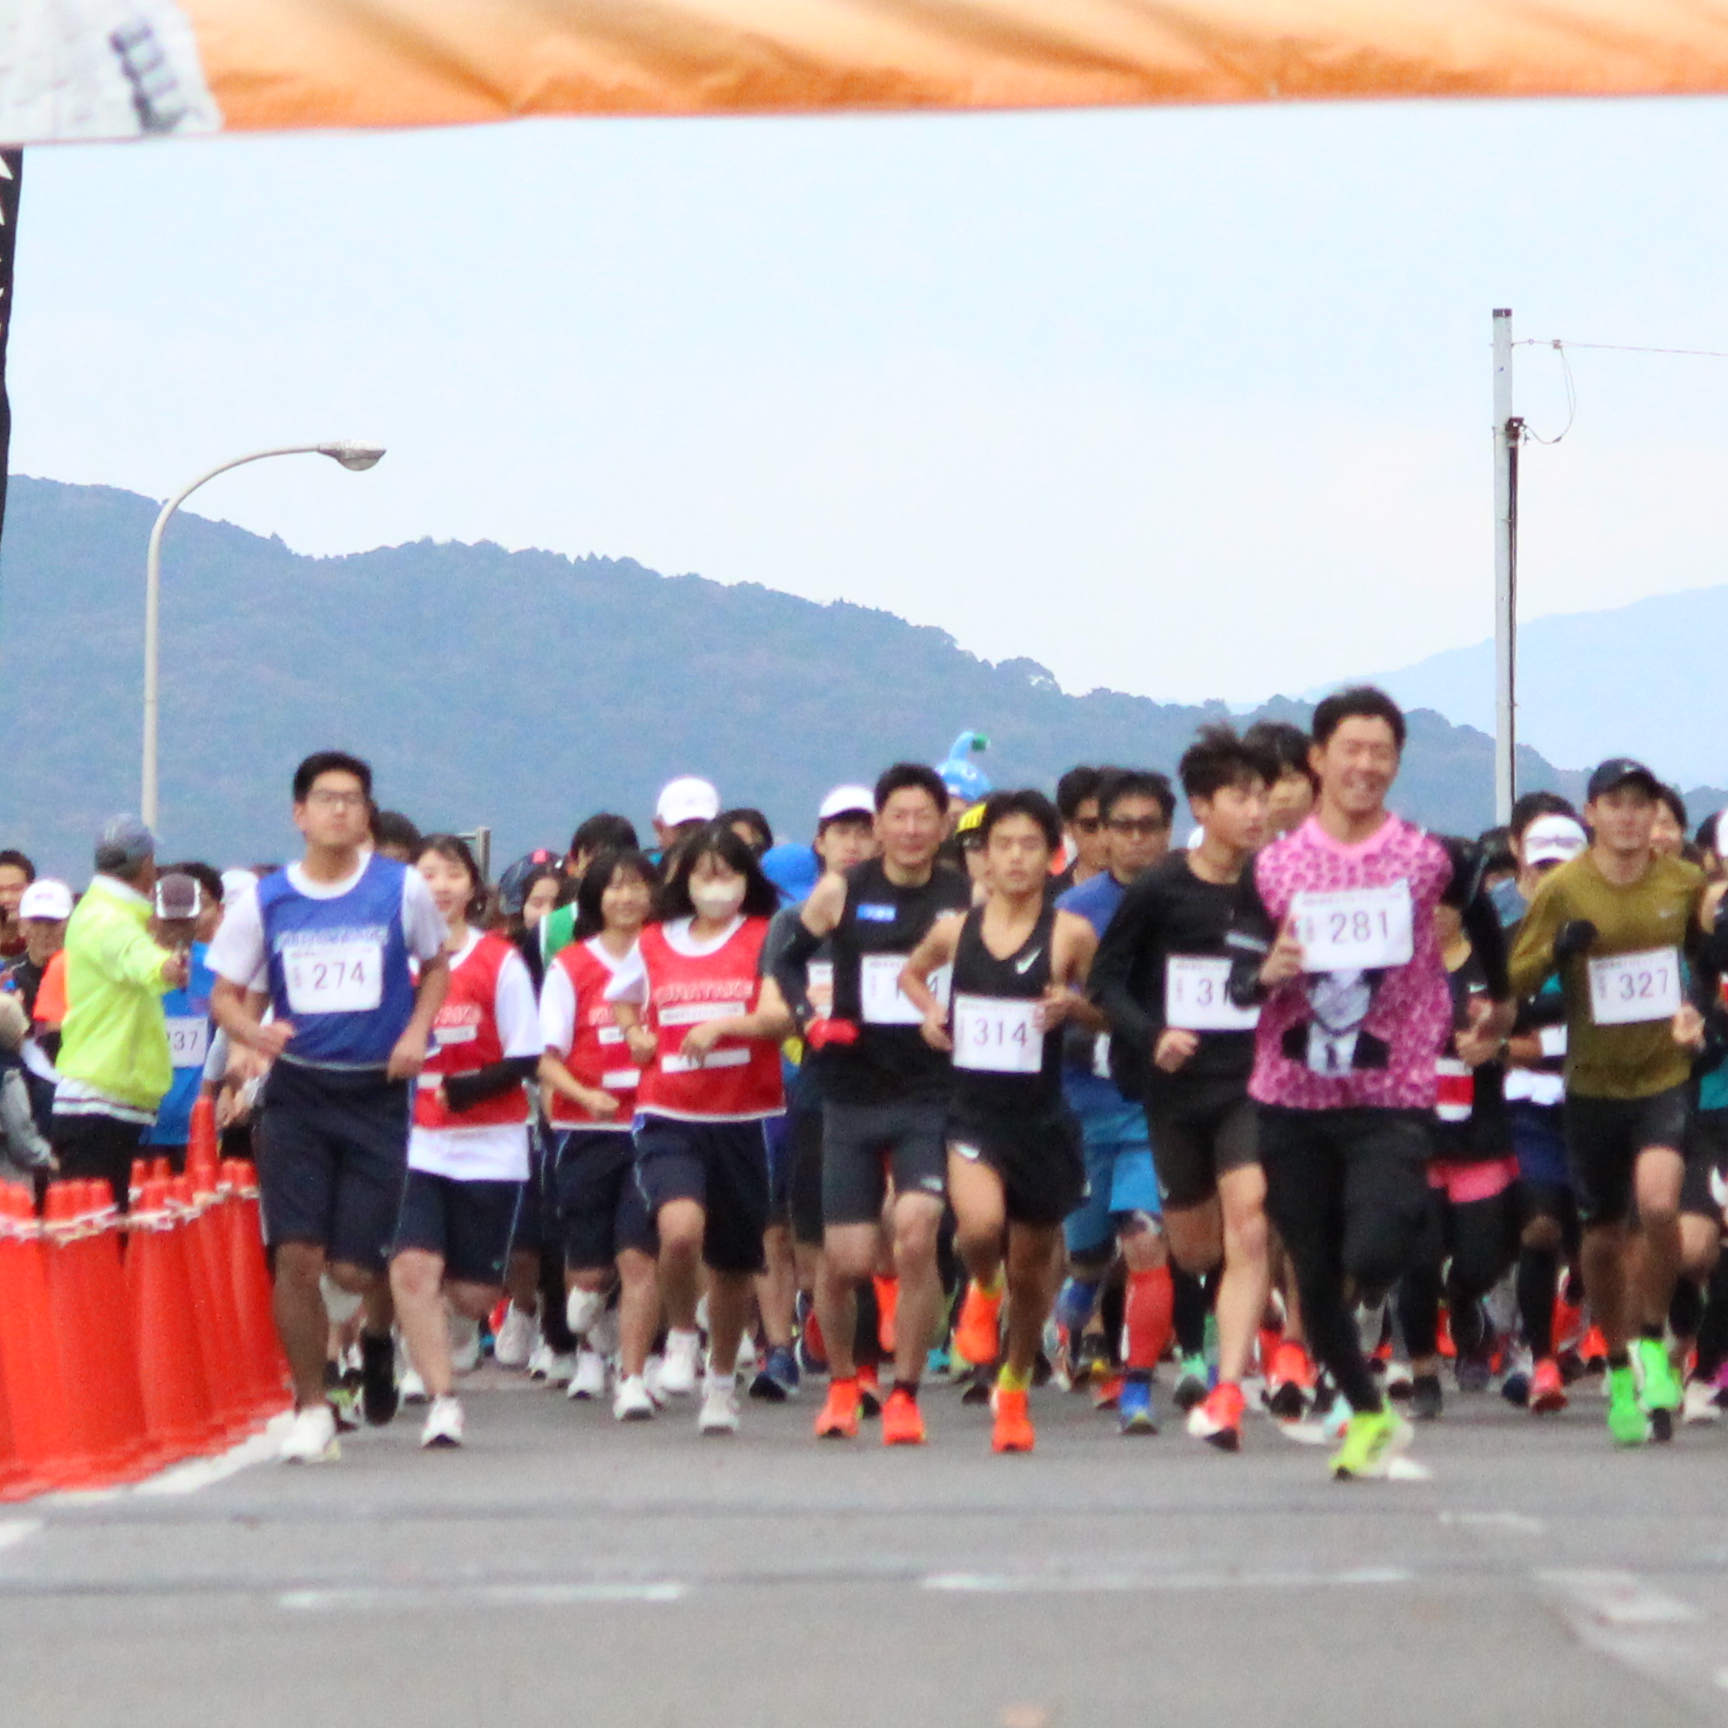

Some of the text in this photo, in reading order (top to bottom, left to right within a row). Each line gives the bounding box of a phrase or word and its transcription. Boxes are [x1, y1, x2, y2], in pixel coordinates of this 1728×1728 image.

[1330, 909, 1389, 944] 281
[313, 960, 366, 990] 274
[1619, 968, 1670, 1002] 327
[973, 1016, 1029, 1049] 314
